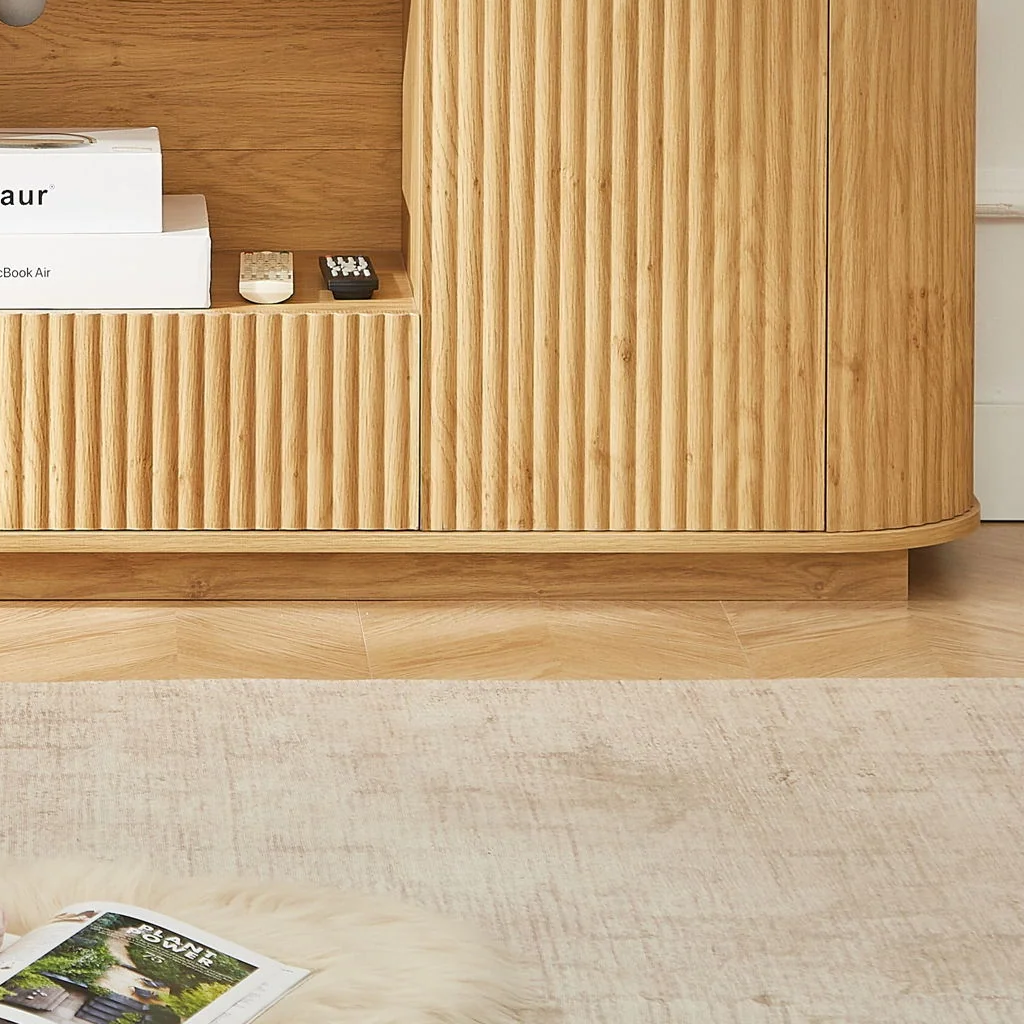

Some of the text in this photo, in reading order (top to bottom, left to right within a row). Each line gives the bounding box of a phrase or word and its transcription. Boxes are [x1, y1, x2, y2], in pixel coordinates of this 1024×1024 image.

[34, 266, 52, 278] Air
[126, 926, 214, 968] POWER
[137, 923, 218, 959] PLANT
